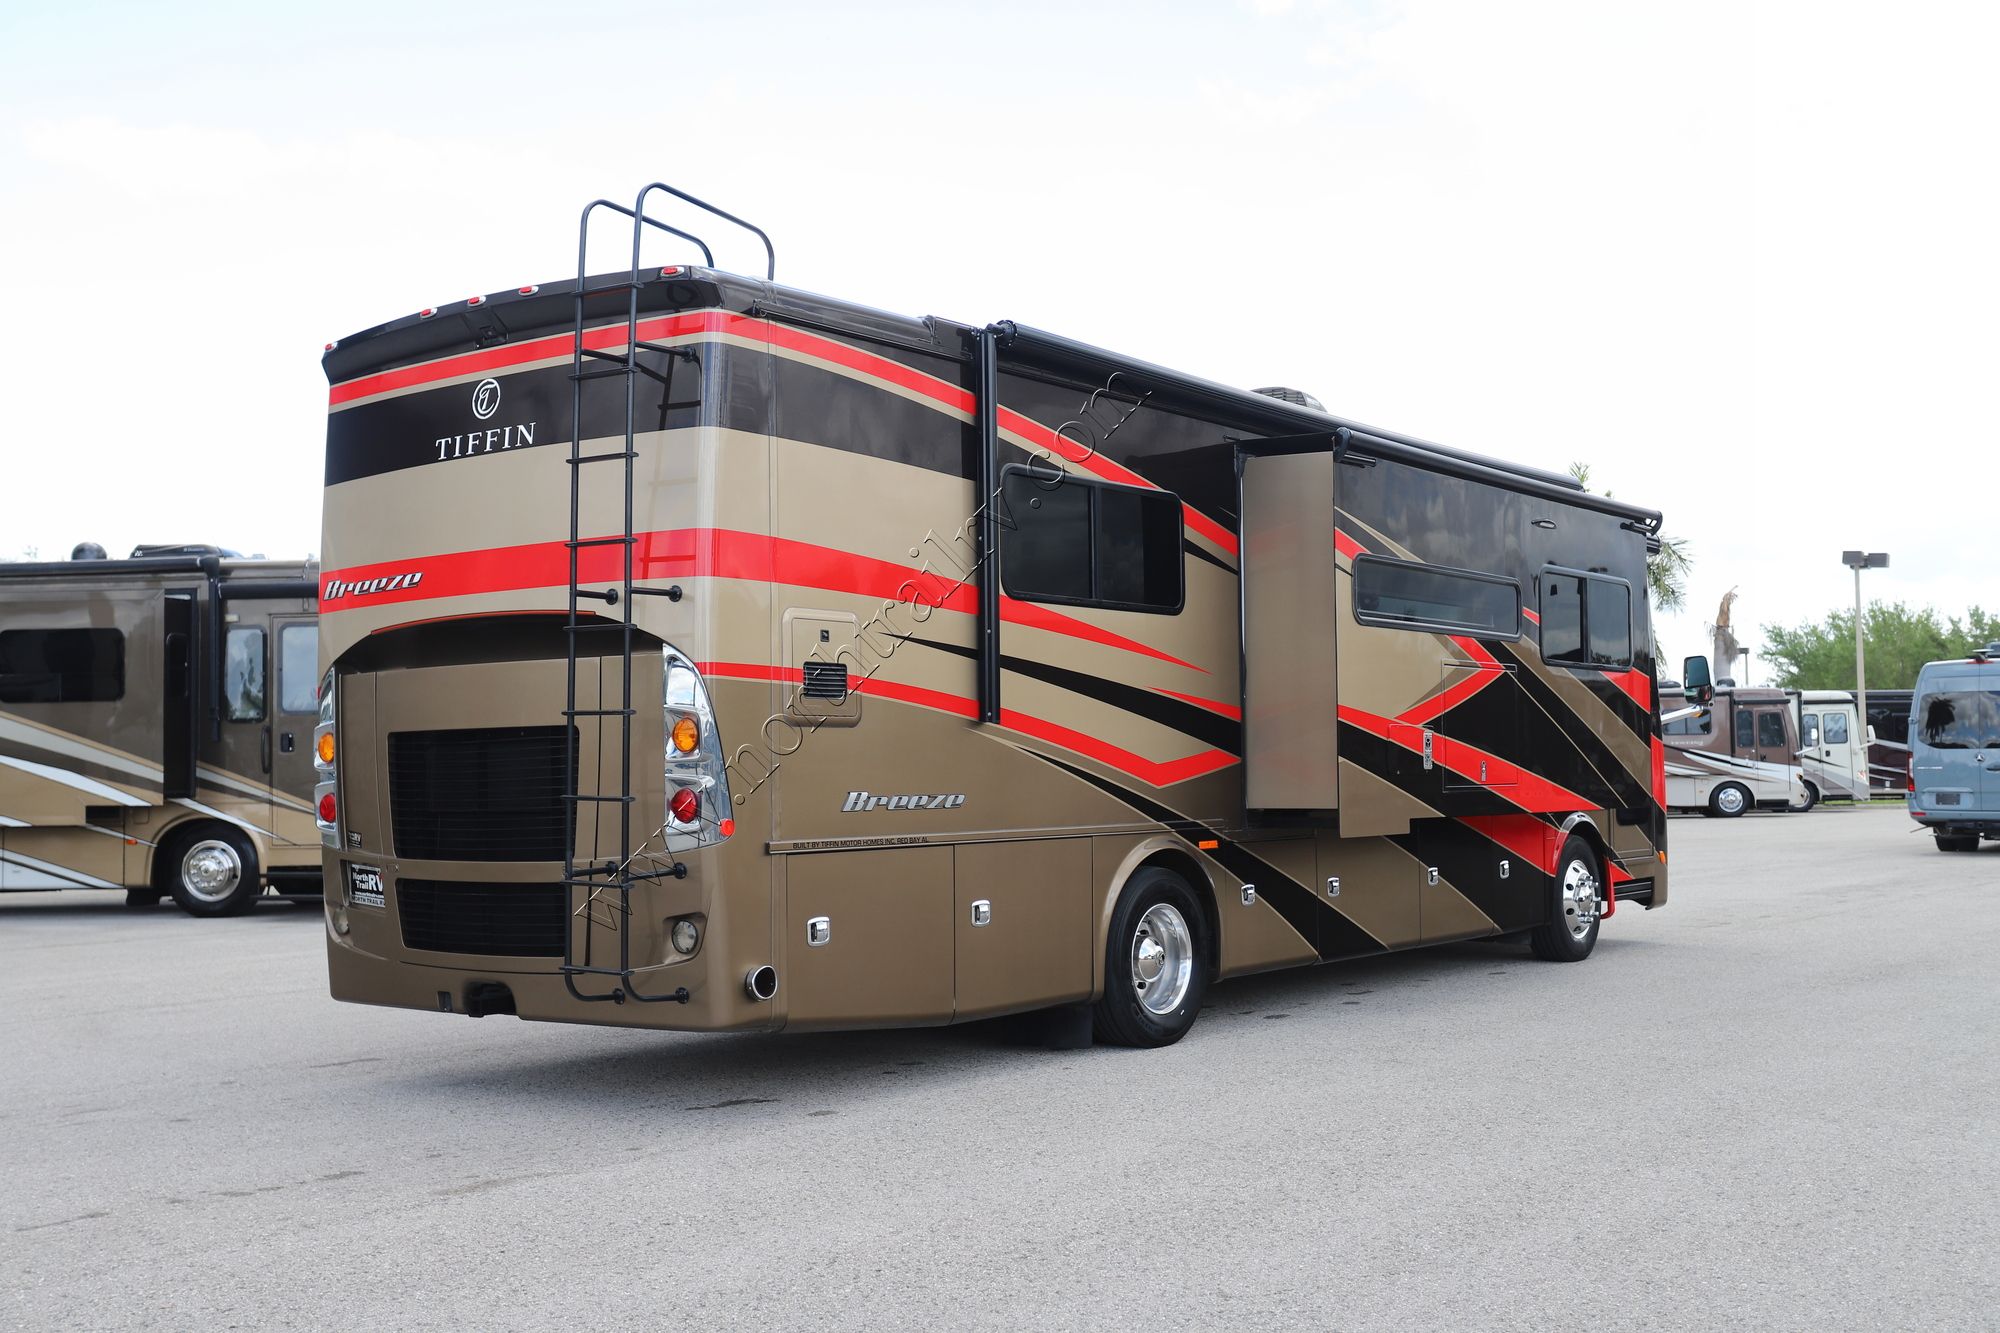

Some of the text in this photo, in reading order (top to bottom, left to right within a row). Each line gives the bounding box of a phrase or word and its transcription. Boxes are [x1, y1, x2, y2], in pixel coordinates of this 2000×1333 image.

[435, 422, 537, 460] TIFFIN
[322, 572, 424, 601] Breeze
[841, 791, 966, 813] Breeze
[792, 841, 811, 849] BUILT
[820, 840, 840, 848] TIFFIN
[840, 839, 862, 847] MOTOR
[862, 838, 883, 846] HOMES
[910, 836, 921, 844] BAY
[352, 872, 383, 892] North RV
[356, 881, 369, 890] Trail
